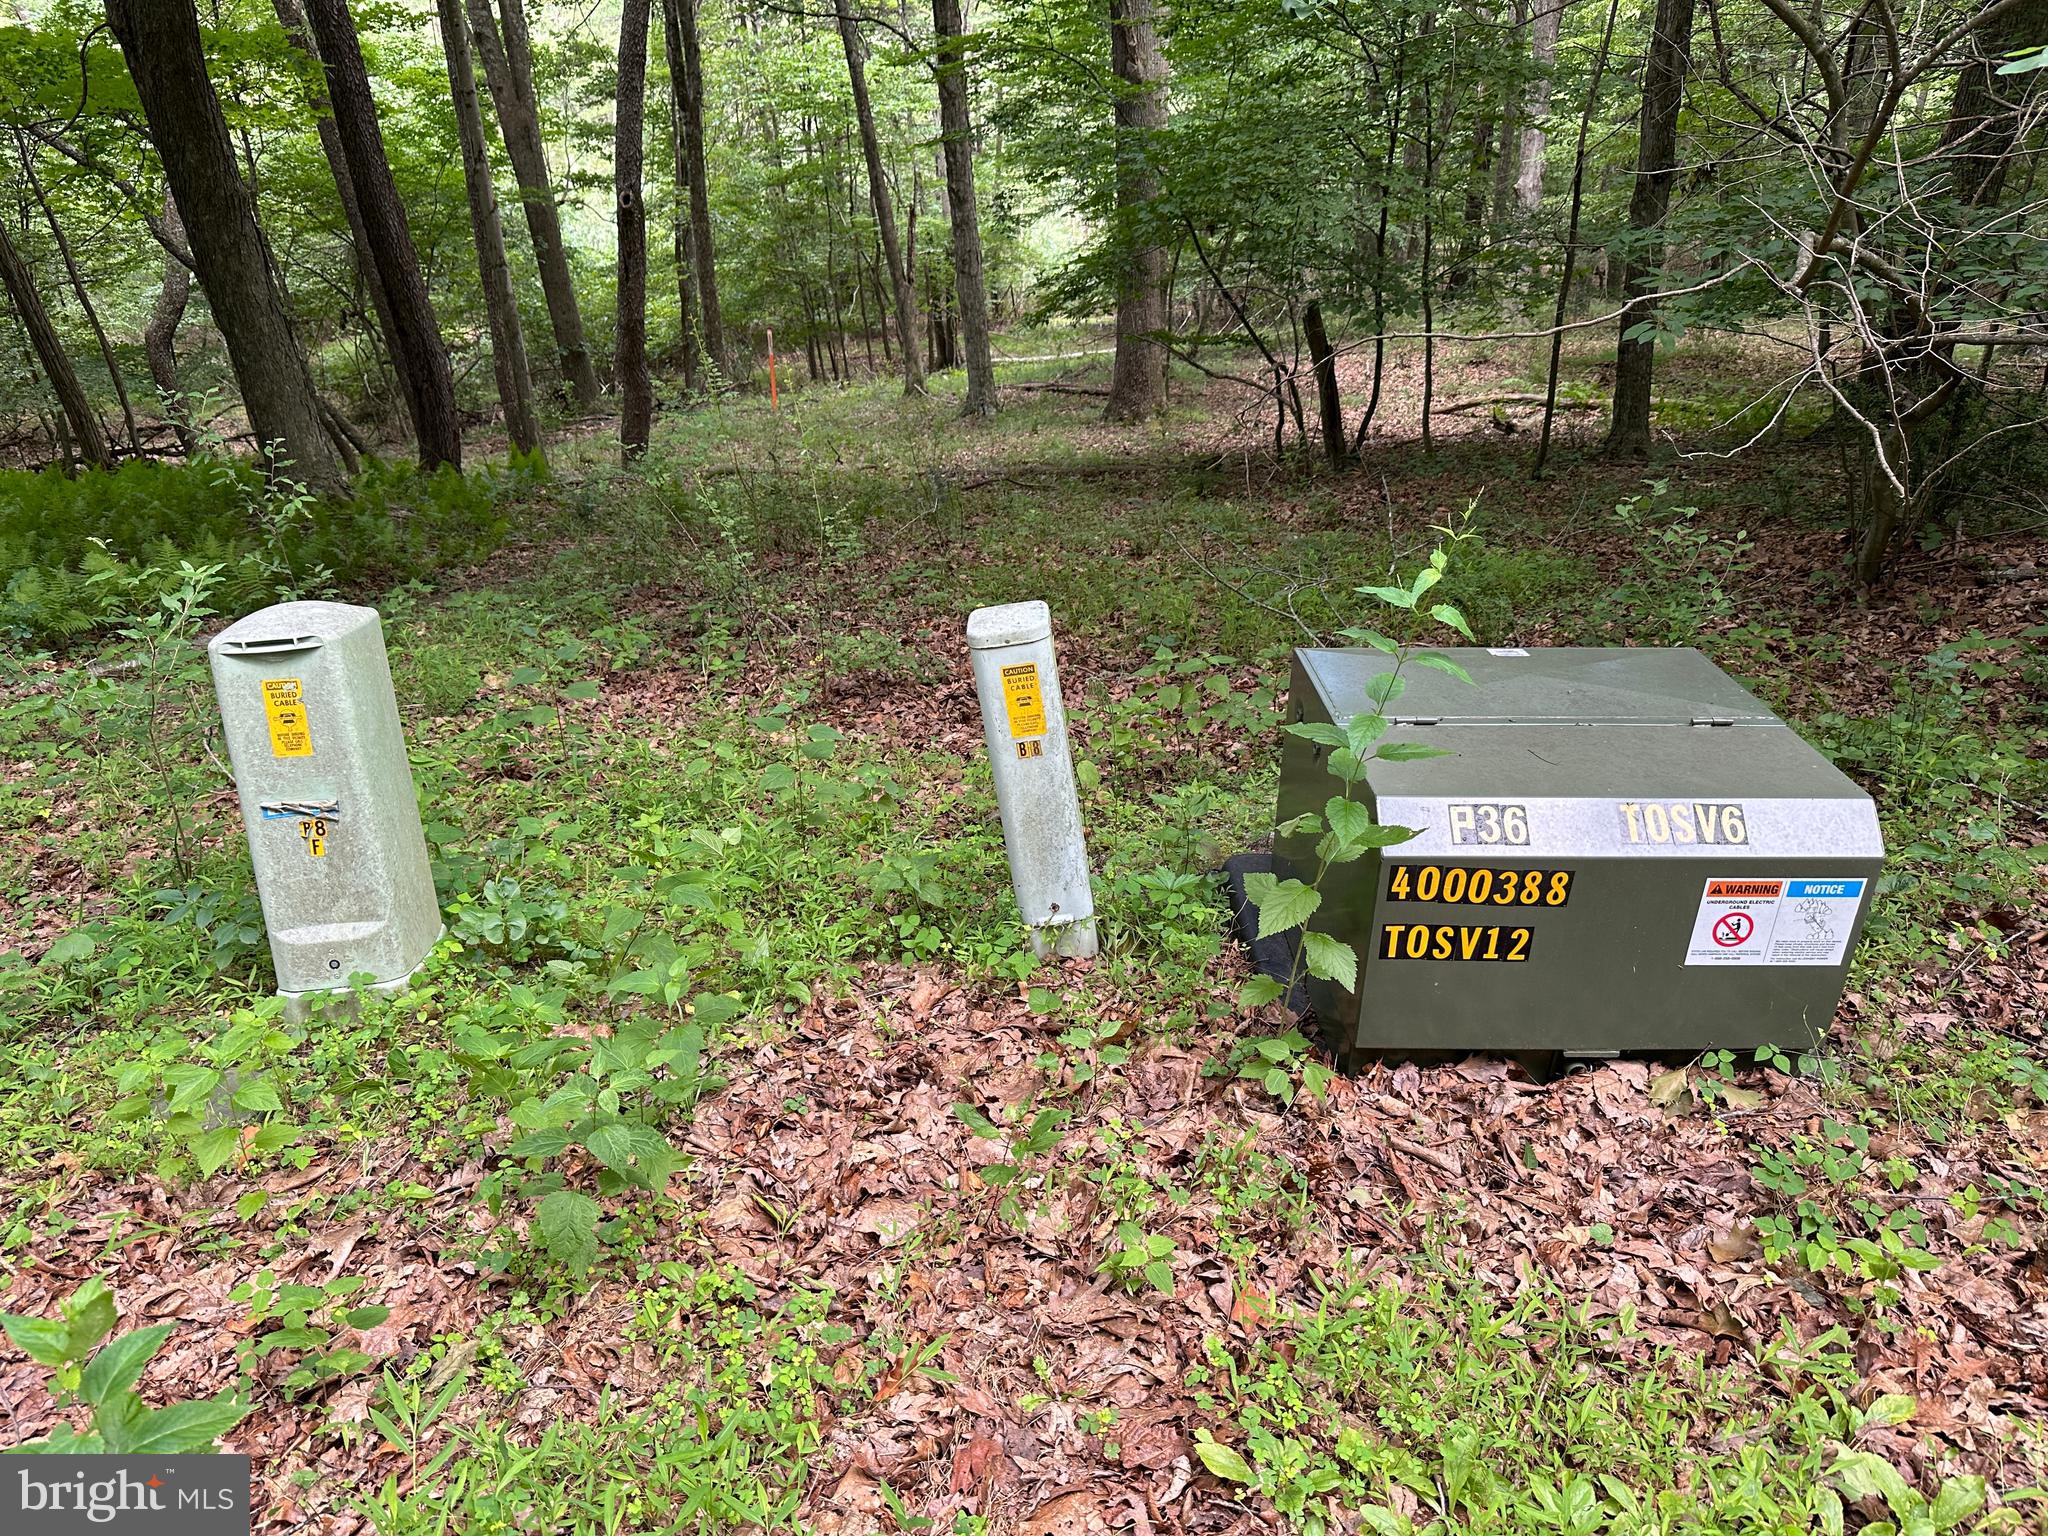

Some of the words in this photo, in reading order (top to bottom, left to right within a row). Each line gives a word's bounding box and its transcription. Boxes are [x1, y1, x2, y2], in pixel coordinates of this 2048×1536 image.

[1004, 665, 1034, 676] CAUTION
[1007, 675, 1035, 684] BURIED
[266, 681, 298, 690] CAUTN
[1010, 683, 1035, 692] CABLE
[270, 691, 298, 700] BURIED
[273, 699, 297, 707] CABLE
[1450, 805, 1528, 844] P36
[312, 839, 320, 855] F
[1391, 866, 1570, 906] 4000388
[1725, 884, 1779, 895] WARNING
[1804, 884, 1846, 895] NOTICE
